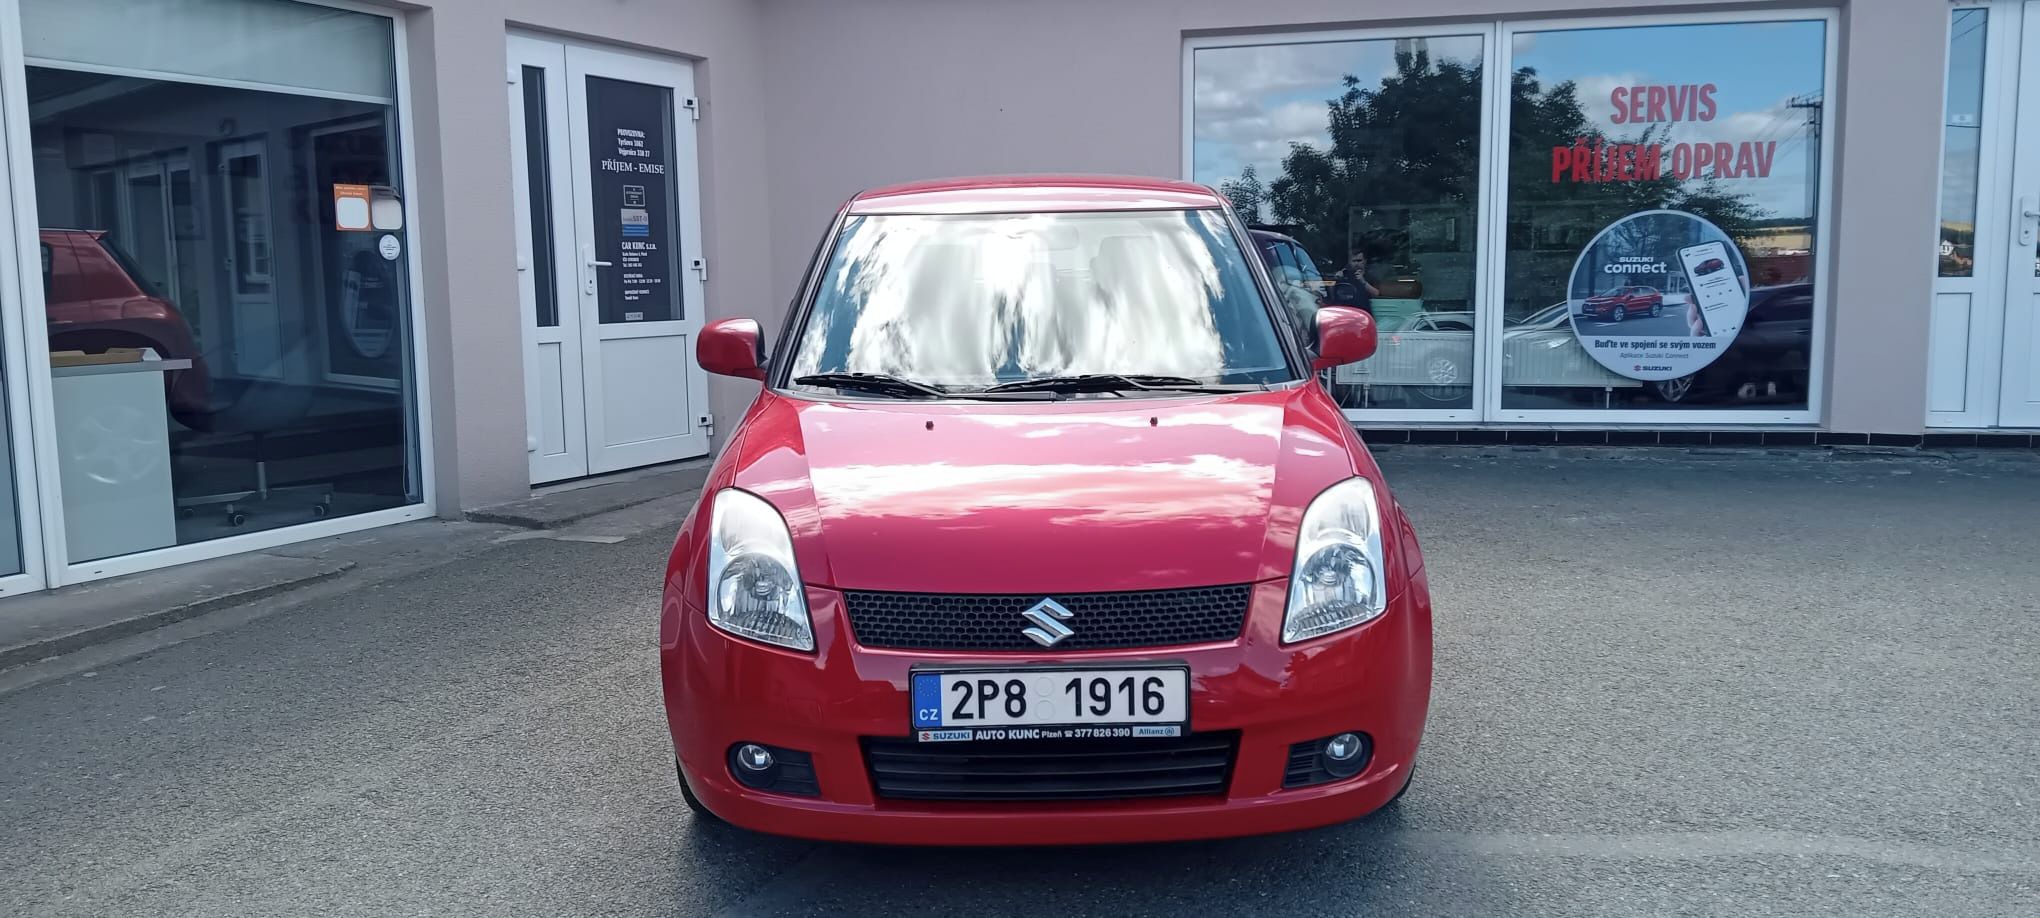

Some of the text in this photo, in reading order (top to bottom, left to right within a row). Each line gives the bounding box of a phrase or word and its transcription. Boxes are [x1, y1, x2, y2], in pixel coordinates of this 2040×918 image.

[1610, 83, 1717, 125] SERVIS
[1552, 135, 1777, 183] PŘÍJEM OPRAV
[601, 159, 633, 173] PŘÍJEM
[639, 163, 665, 174] EMISE
[621, 241, 632, 250] CAR
[1604, 262, 1668, 274] connect
[1594, 340, 1618, 349] Buďte
[1630, 340, 1658, 350] spojení
[1670, 341, 1691, 350] svým
[951, 676, 1165, 720] 2P8 1916
[919, 708, 938, 721] CZ
[933, 731, 970, 740] SUZUKI
[975, 729, 1006, 740] AUTO
[1008, 728, 1040, 739] KUNC
[1041, 730, 1063, 739] Plzeň
[1139, 727, 1164, 736] Allianz
